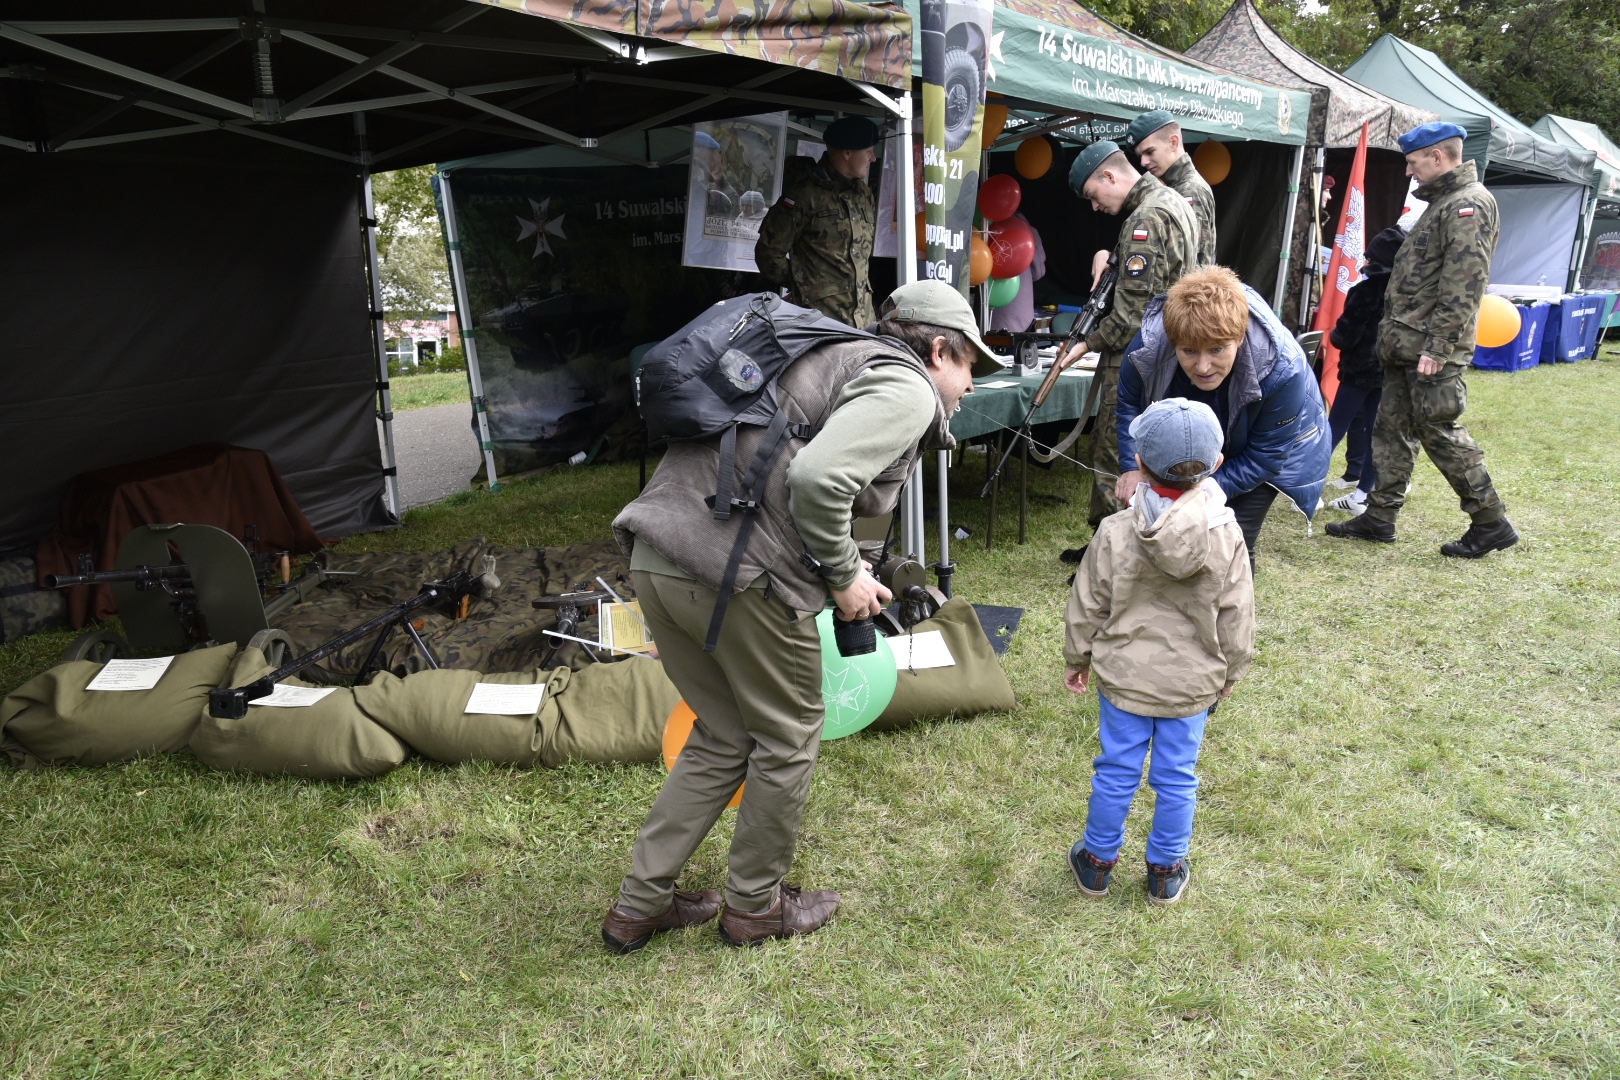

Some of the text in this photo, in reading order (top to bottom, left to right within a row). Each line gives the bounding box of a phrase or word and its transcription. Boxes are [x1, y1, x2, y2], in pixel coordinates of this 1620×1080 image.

[1037, 25, 1057, 57] 14
[1061, 33, 1133, 78] Suwalski
[1136, 55, 1169, 87] Pułk
[1072, 70, 1095, 98] im.
[1096, 78, 1156, 110] Marszałka
[949, 159, 964, 180] 21
[594, 200, 615, 220] 14
[632, 233, 652, 247] im.
